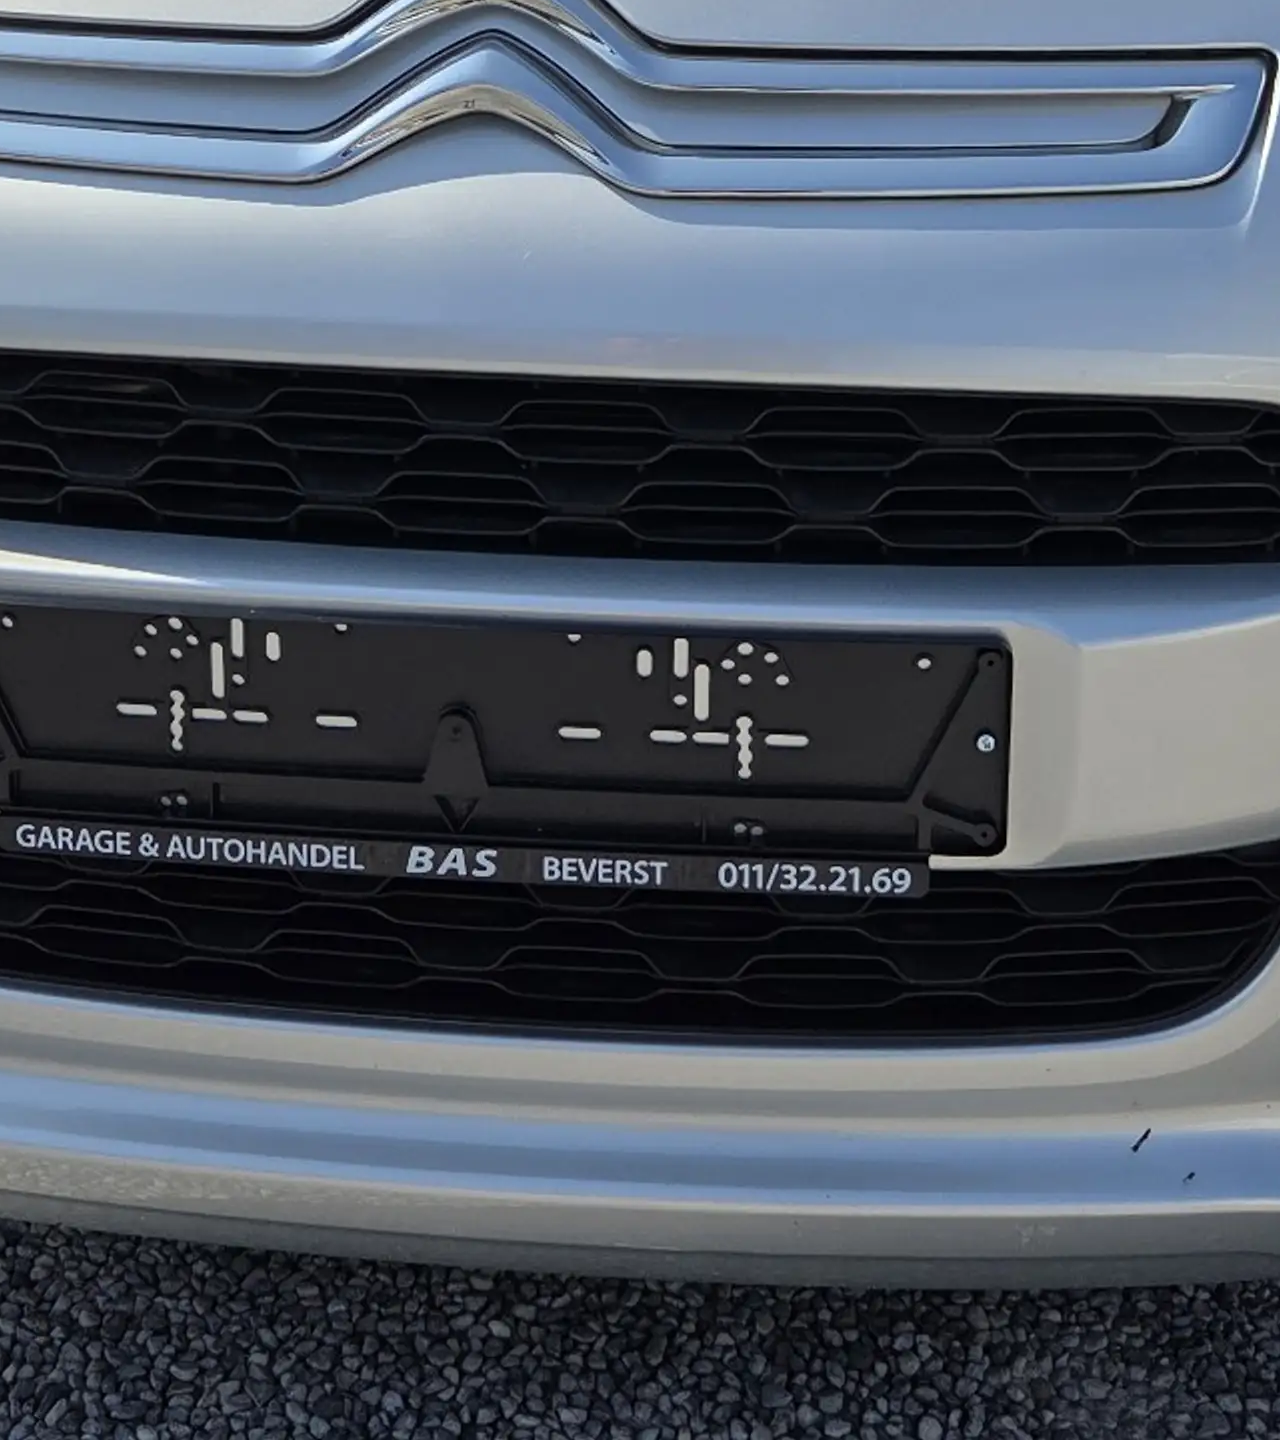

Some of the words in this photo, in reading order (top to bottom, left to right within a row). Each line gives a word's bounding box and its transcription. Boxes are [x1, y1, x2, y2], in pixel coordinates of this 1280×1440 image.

[15, 823, 133, 856] GARAGE
[137, 832, 160, 858] &
[166, 834, 365, 872] AUTOHANDEL
[405, 845, 498, 878] BAS
[542, 856, 669, 887] BEVERST
[717, 861, 912, 895] 011/32.21.69
